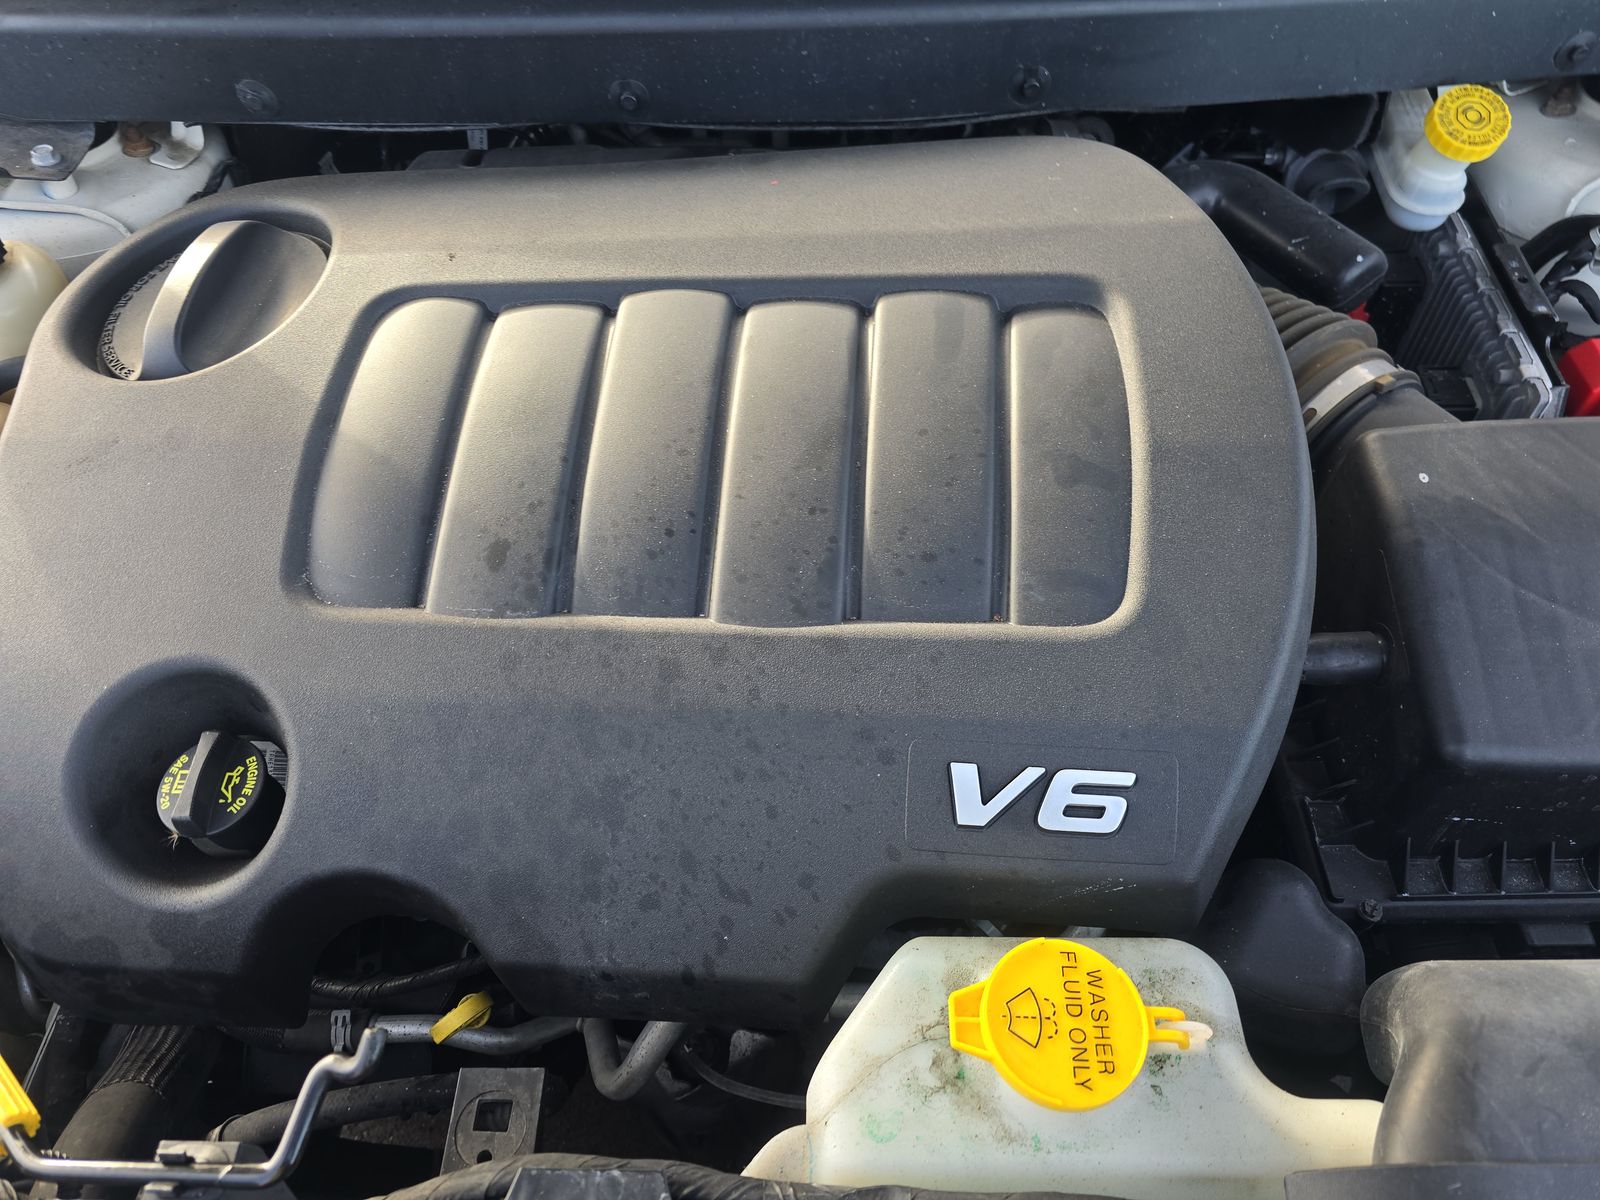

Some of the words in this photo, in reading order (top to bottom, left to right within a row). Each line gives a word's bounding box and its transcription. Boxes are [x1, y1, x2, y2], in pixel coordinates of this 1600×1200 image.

[102, 311, 121, 345] FILTER
[102, 345, 135, 378] SERVICE
[169, 754, 189, 775] SAE
[241, 755, 259, 796] ENGINE
[160, 776, 174, 810] 5W-20
[227, 797, 247, 815] OIL
[949, 761, 1137, 834] V6
[1059, 951, 1083, 1018] FLUID
[1086, 969, 1115, 1075] WASHER
[1068, 1028, 1093, 1092] ONLY
